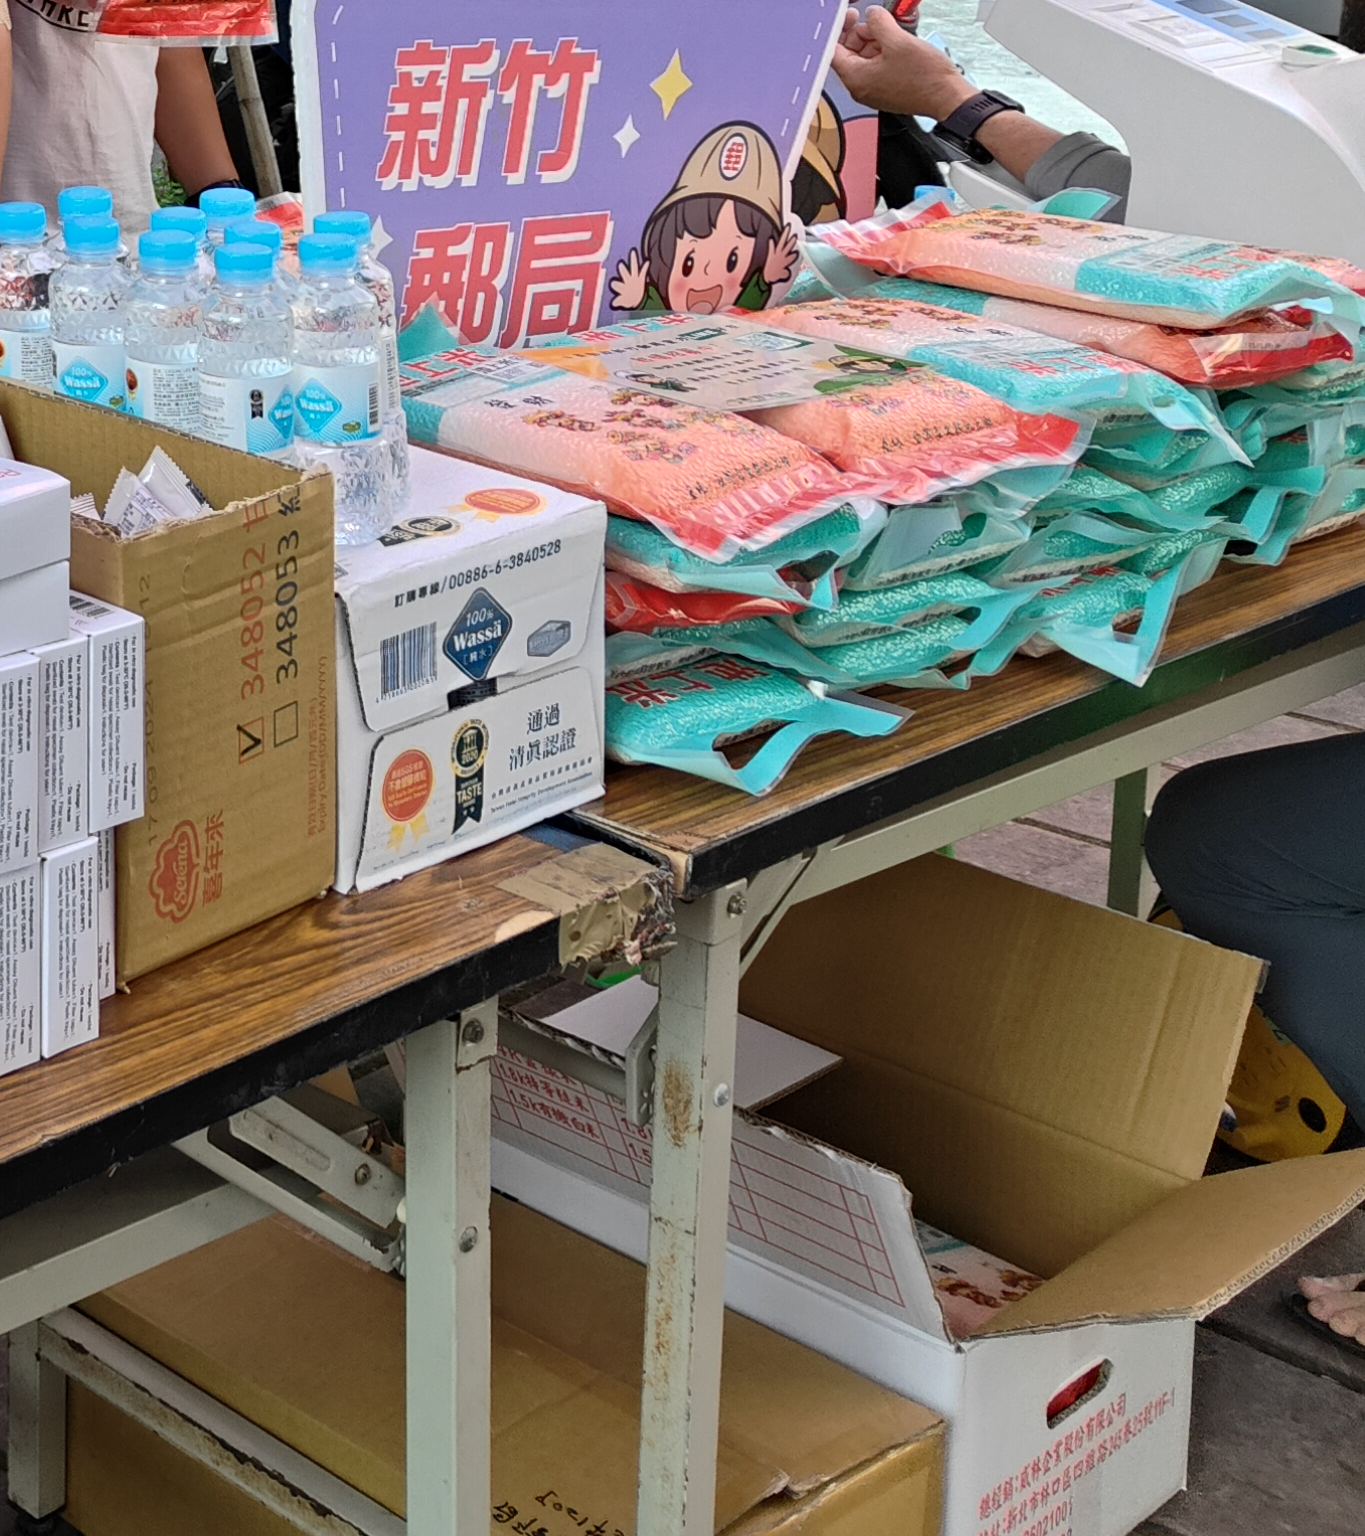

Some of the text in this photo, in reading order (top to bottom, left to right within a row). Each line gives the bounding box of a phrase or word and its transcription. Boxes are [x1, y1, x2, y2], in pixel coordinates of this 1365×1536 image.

[377, 37, 599, 191] 新竹
[399, 207, 615, 351] 郵局
[239, 547, 268, 702] 348052
[274, 530, 301, 681] 348053
[453, 619, 503, 653] Wassä
[466, 606, 495, 628] 100%
[526, 702, 561, 735] 通過
[456, 781, 482, 804] TASTE
[200, 808, 225, 908] 喜年來
